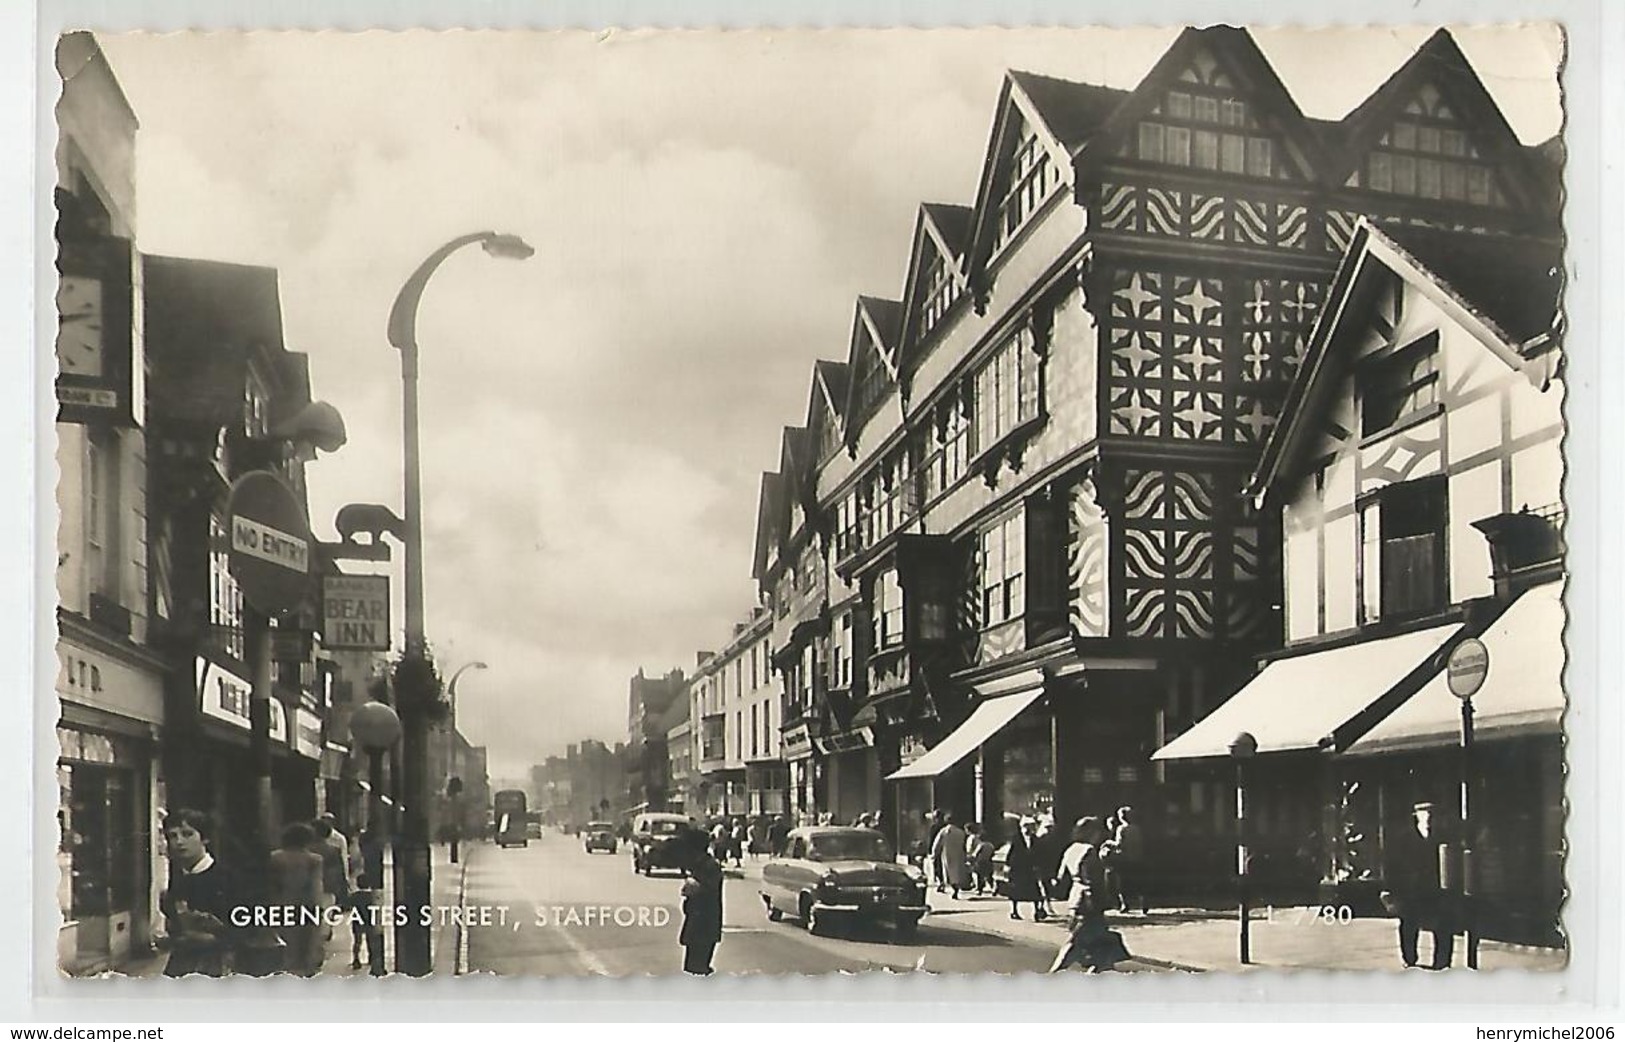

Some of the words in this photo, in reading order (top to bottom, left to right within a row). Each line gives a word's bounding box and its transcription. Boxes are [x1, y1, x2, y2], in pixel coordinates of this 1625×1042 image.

[236, 523, 258, 549] NO
[263, 532, 306, 566] ENTRY
[326, 599, 383, 620] BEAR
[334, 622, 376, 644] INN
